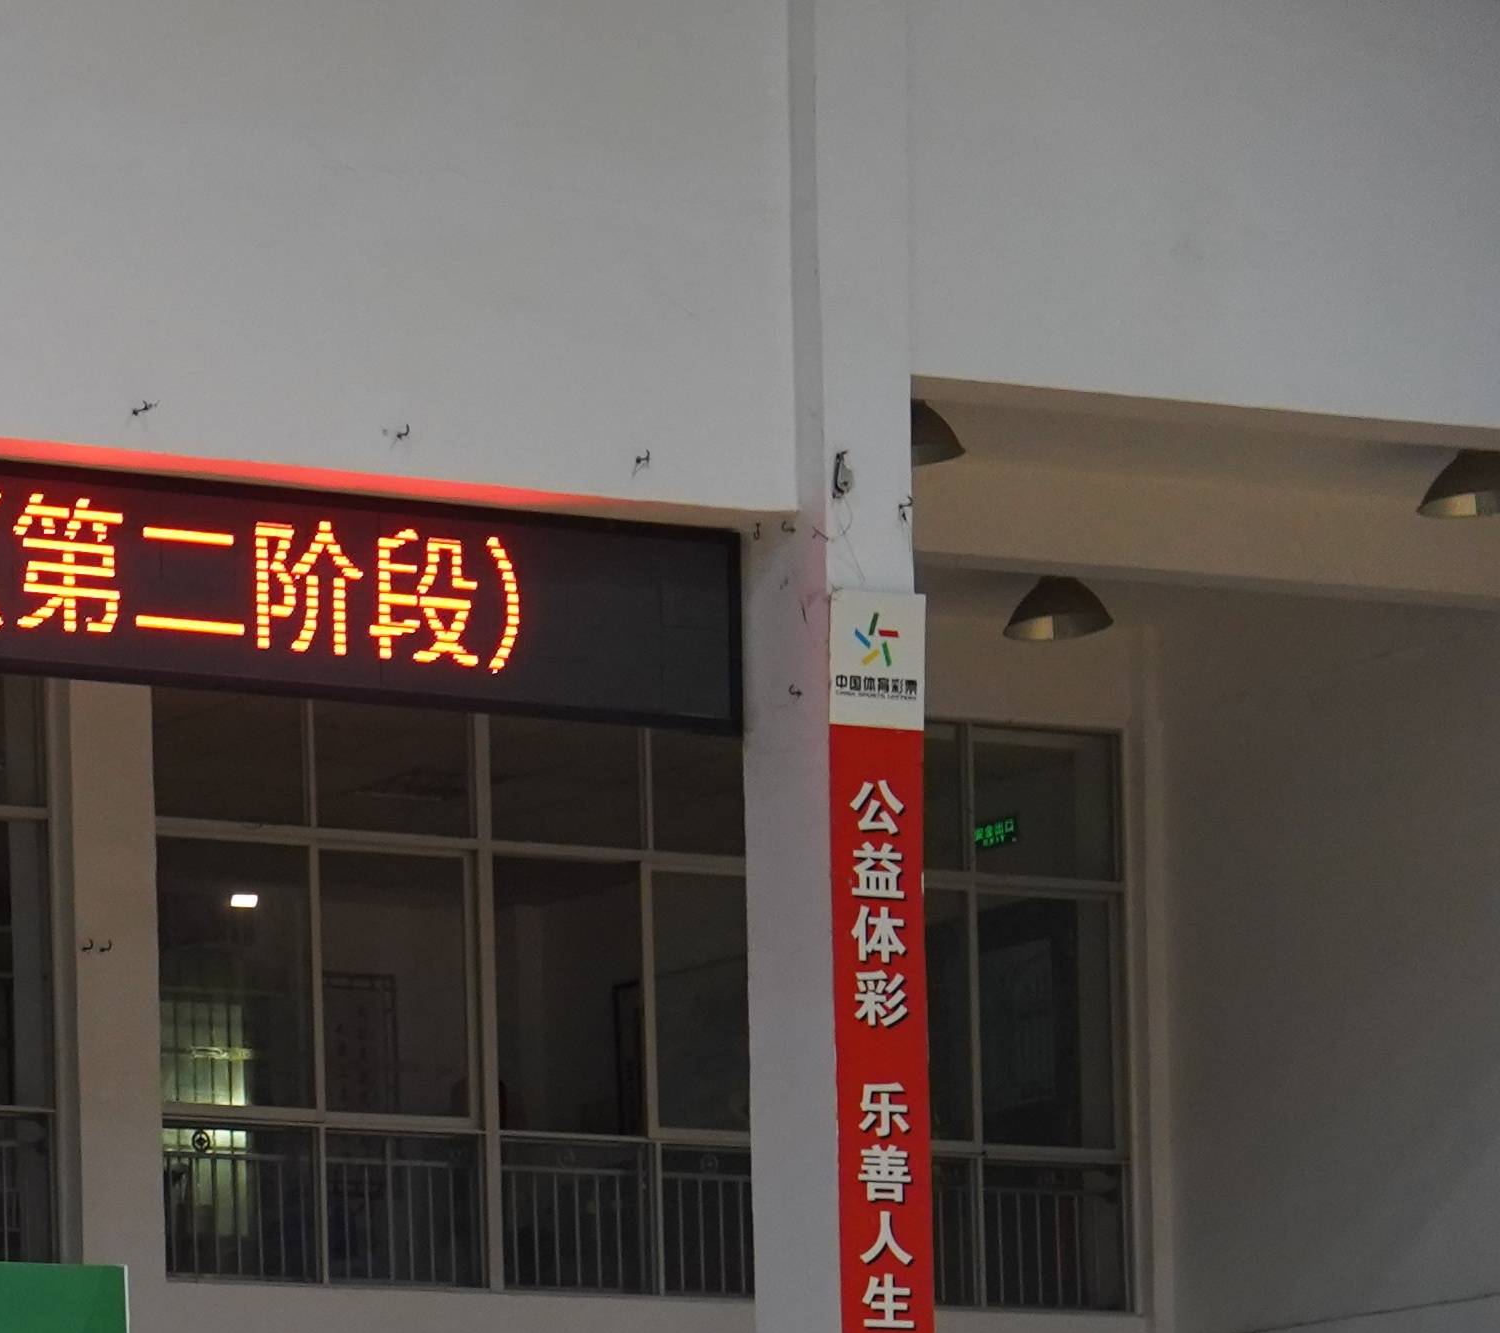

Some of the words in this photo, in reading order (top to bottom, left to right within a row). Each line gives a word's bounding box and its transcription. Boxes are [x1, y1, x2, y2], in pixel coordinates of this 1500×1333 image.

[835, 674, 918, 695] 中国体育彩票
[850, 778, 909, 1029] 公益体彩
[857, 1080, 916, 1333] 乐善人生
